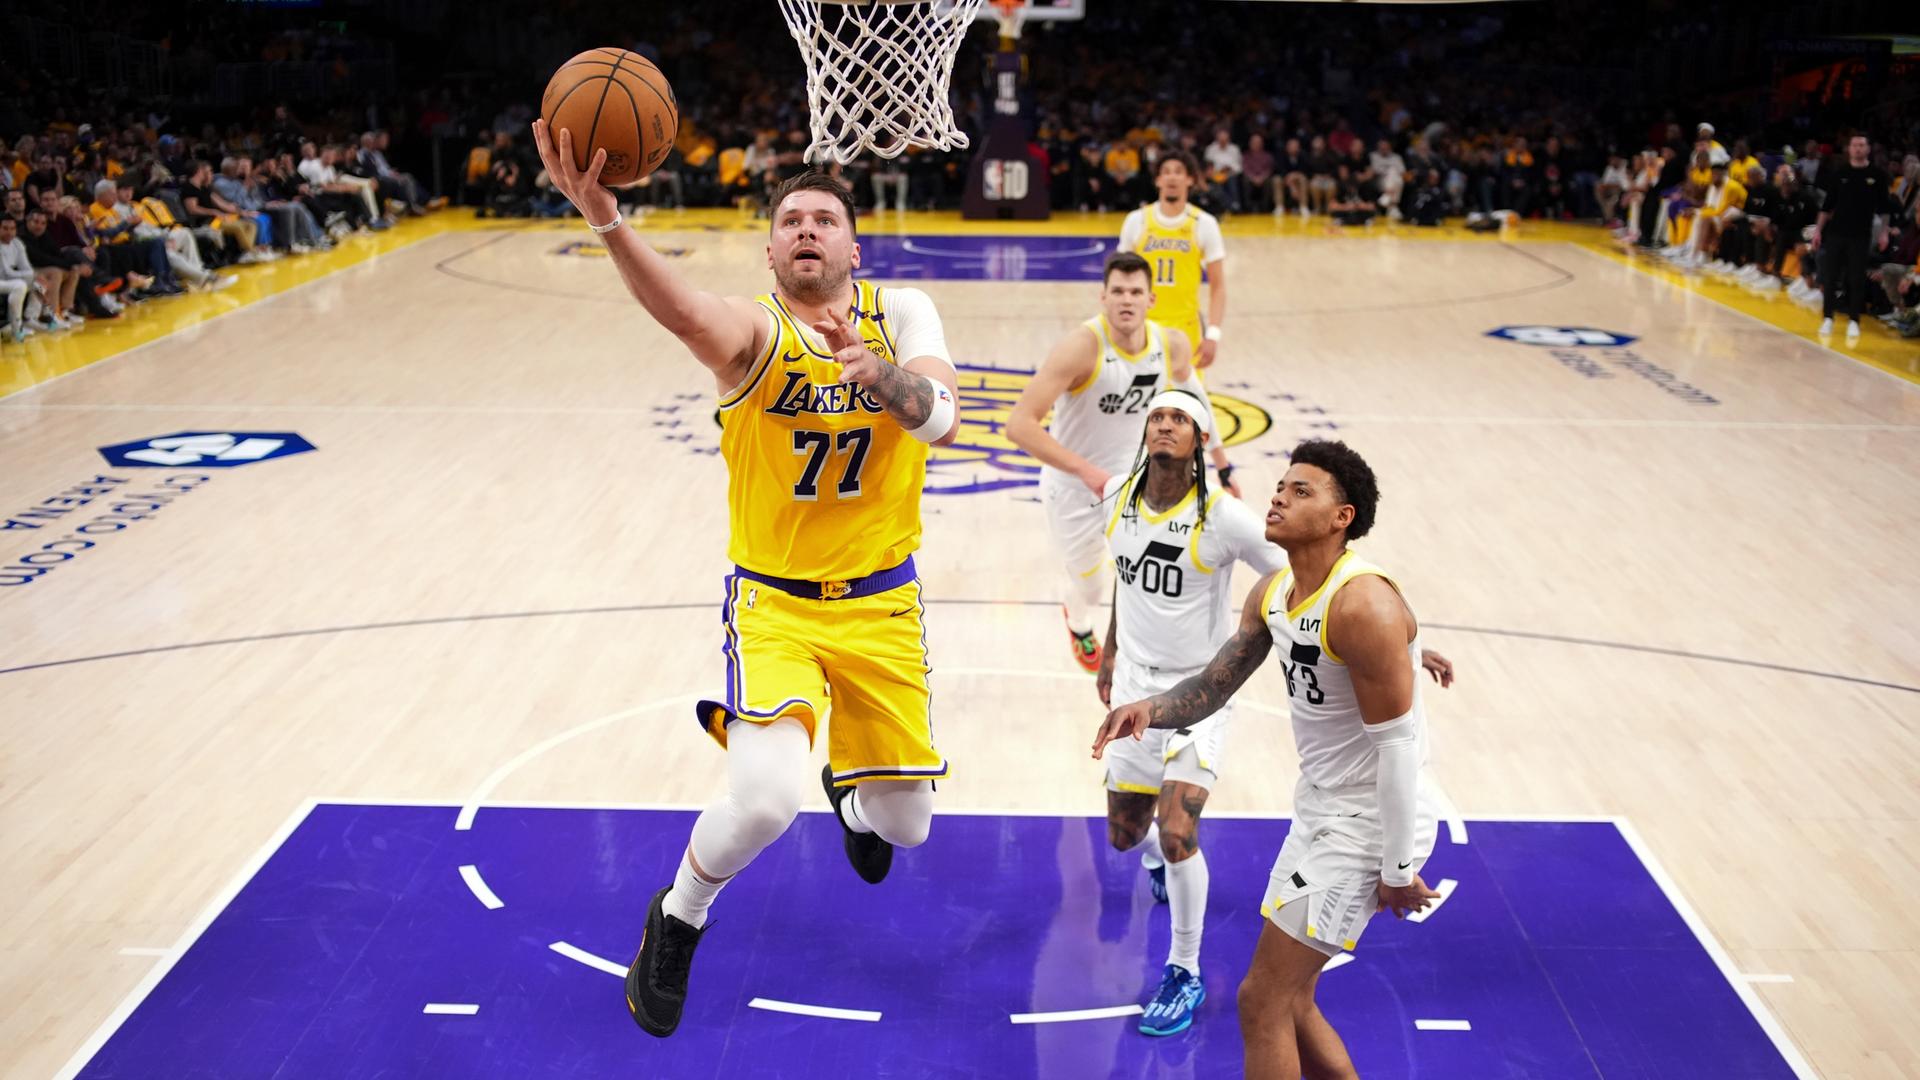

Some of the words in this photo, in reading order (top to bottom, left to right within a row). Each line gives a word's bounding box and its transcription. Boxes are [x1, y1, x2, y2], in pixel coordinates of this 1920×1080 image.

[1155, 257, 1175, 286] 11
[792, 427, 872, 501] 77
[0, 474, 130, 532] ARENA
[1142, 559, 1184, 598] 00
[1299, 617, 1321, 633] LVT
[1301, 665, 1325, 705] 3
